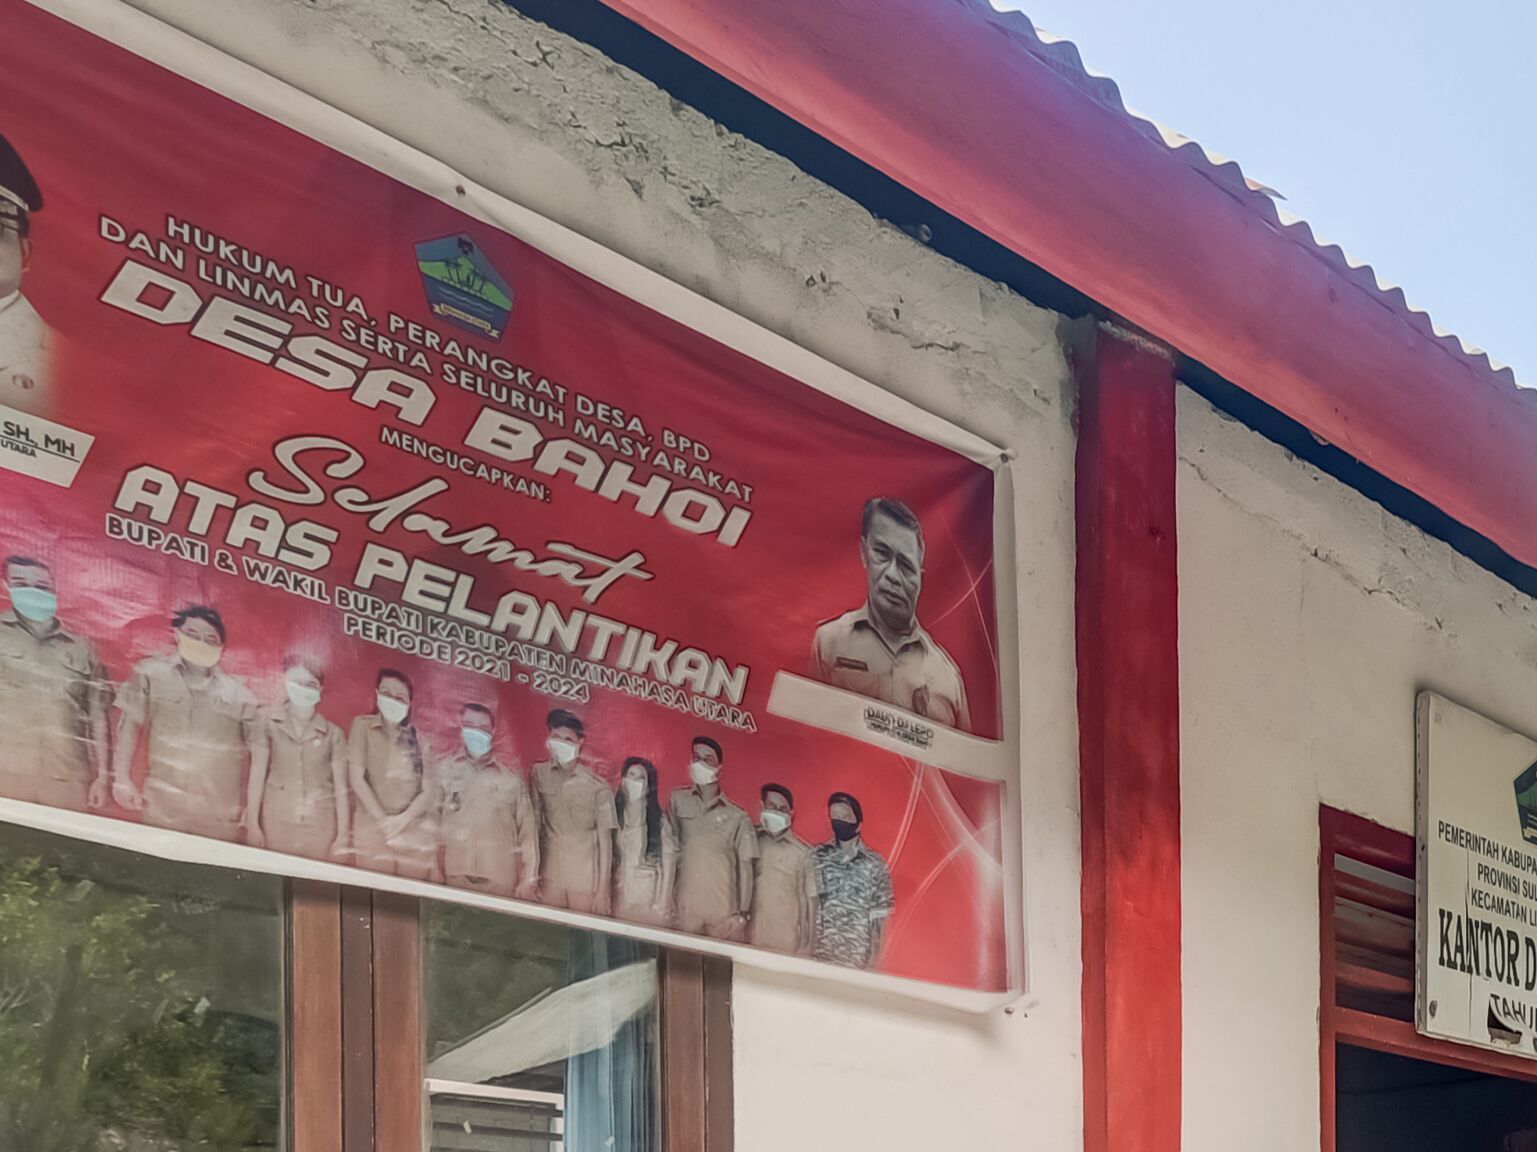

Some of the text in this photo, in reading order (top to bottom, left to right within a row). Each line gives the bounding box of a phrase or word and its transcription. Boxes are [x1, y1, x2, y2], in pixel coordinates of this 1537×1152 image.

[100, 216, 753, 502] DAN LINMAS SERTA SELURUH MASYARAKAT
[166, 215, 296, 288] HUKUM
[306, 275, 377, 327] TUA,
[389, 315, 568, 404] PERANGKAT
[576, 393, 653, 442] DESA,
[663, 429, 711, 462] BPD
[44, 433, 75, 457] MH
[100, 259, 752, 548] DESA BAHOI
[0, 438, 37, 458] UTARA
[380, 427, 551, 502] MENGUCAPKAN:
[247, 435, 655, 604] Selamat
[105, 513, 757, 732] BUPATI & WAKIL BUPATI KABUPATEN MINAHASA UTARA
[113, 465, 749, 704] ATAS PELANTIKAN
[344, 613, 450, 661] PERIODE
[455, 648, 511, 682] 2021
[533, 674, 590, 703] 2024
[1438, 820, 1499, 860] PEMERINTAH
[1477, 863, 1520, 894] PROVINSI
[1438, 908, 1520, 987] KANTOR
[1471, 888, 1527, 924] KECAMATAN
